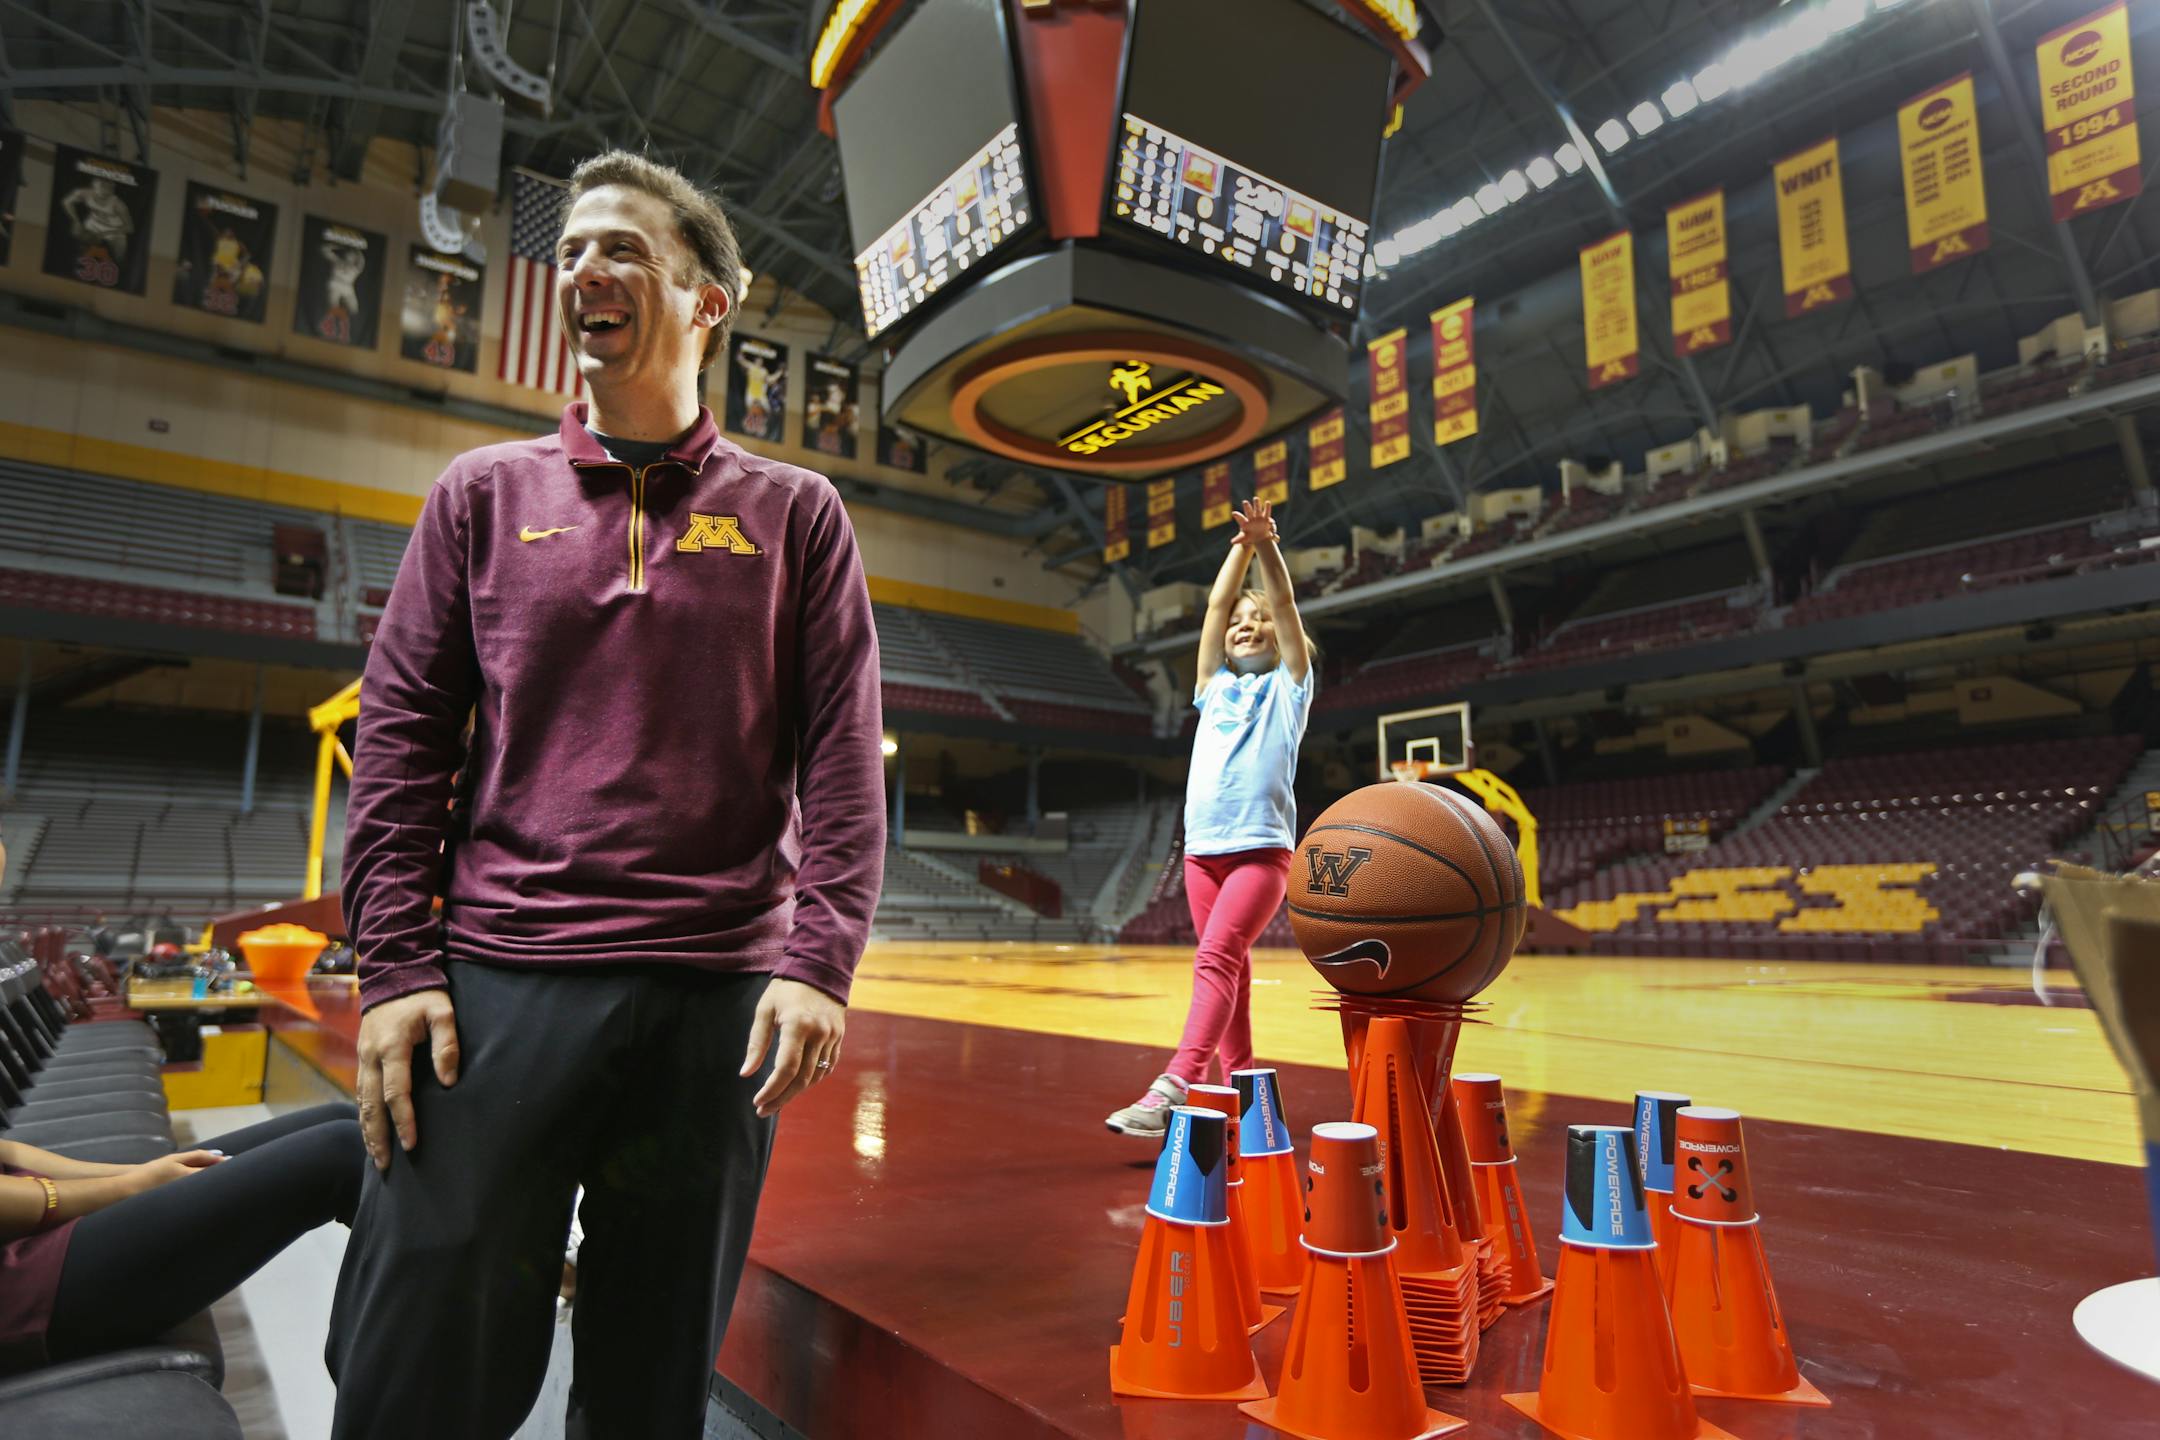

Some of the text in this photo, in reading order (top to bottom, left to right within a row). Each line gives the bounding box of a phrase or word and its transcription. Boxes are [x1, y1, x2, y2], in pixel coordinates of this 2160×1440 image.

[2050, 59, 2121, 98] SECOND
[2057, 77, 2118, 111] ROUND
[2058, 108, 2120, 146] 1994
[1780, 158, 1832, 196] WNIT
[1068, 382, 1225, 455] SECURIAN
[676, 512, 756, 555] M
[1306, 844, 1372, 897] W
[1256, 1077, 1276, 1148] POWERADE
[1164, 1115, 1187, 1208] POWERADE
[1638, 1100, 1652, 1182] POWERADE
[1679, 1140, 1741, 1154] POWERADE
[1604, 1133, 1625, 1237] POWERADE
[1167, 1250, 1185, 1348] UBER
